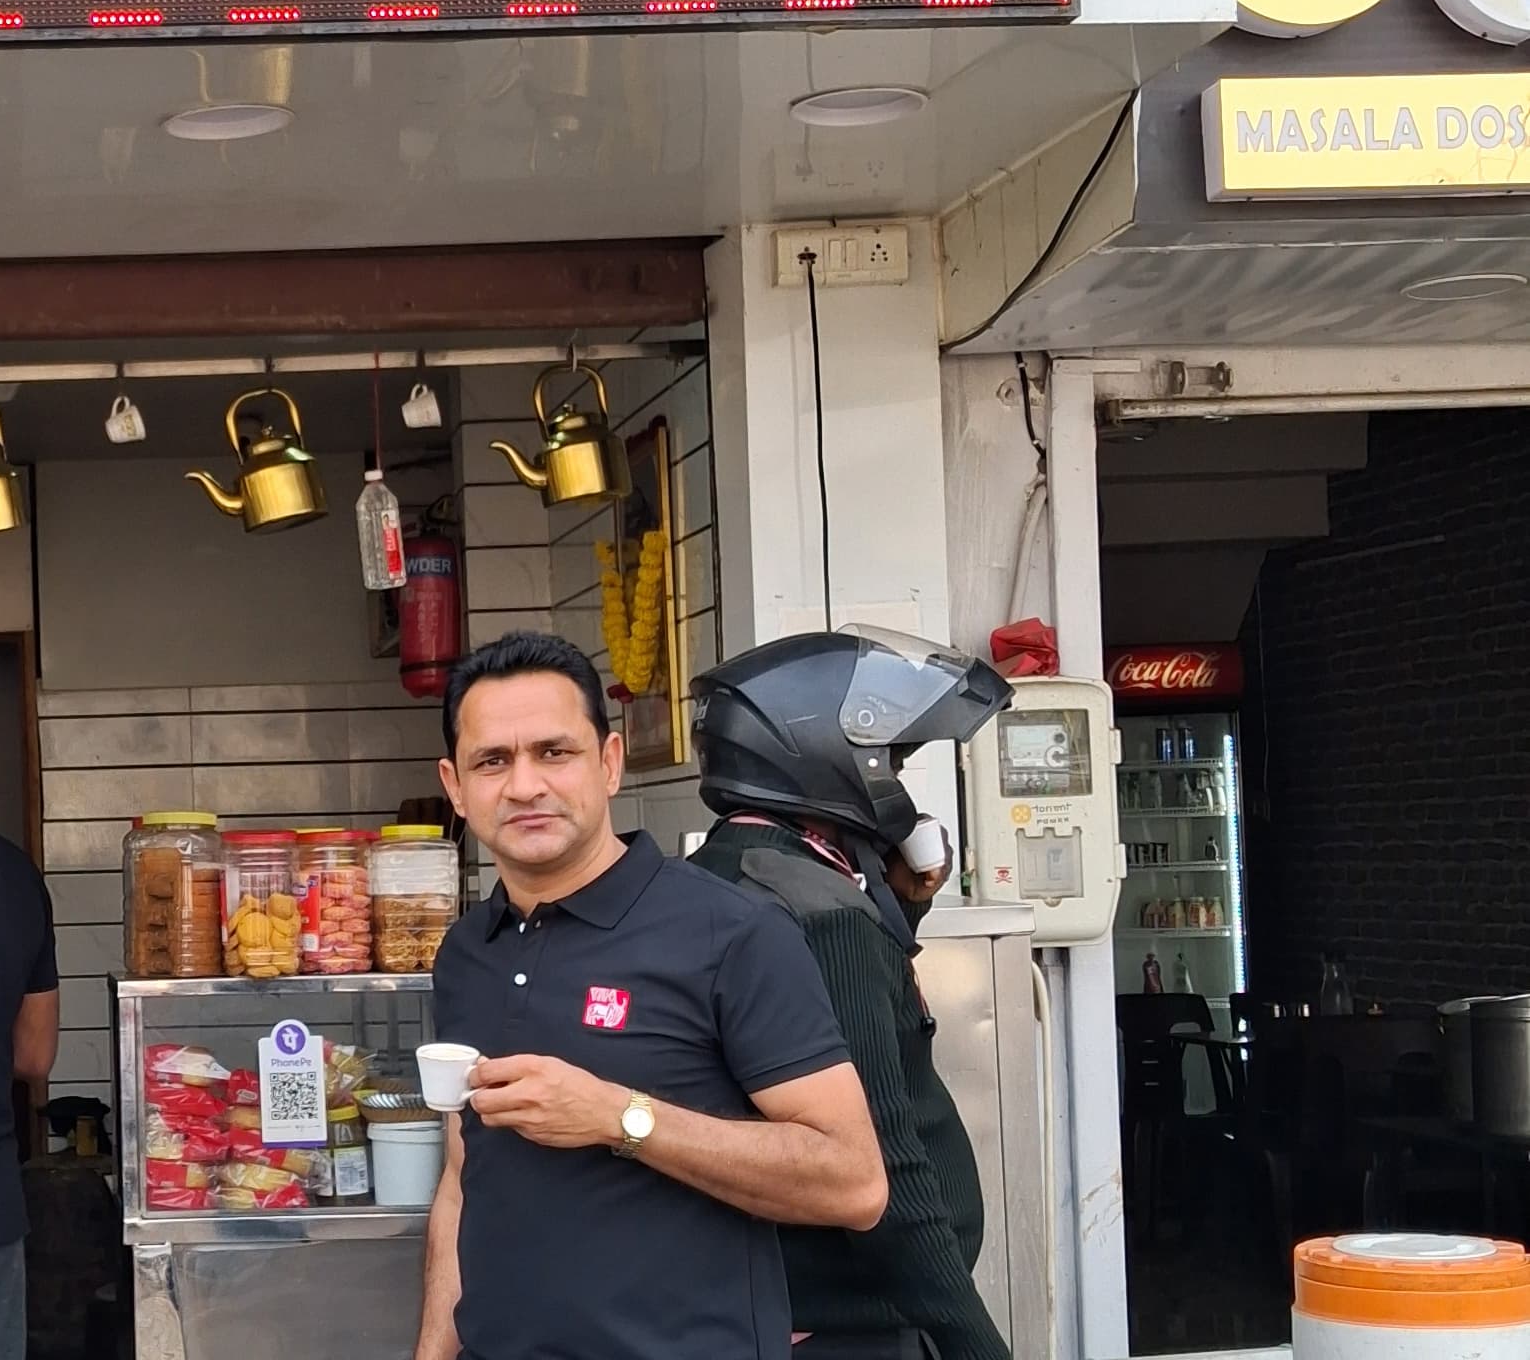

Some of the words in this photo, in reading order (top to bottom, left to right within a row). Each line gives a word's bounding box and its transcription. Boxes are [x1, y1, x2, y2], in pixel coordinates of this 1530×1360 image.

[1236, 107, 1423, 152] MASALA
[1437, 105, 1526, 149] DOS
[406, 556, 452, 573] WDER
[1107, 652, 1222, 690] Coca-Cola
